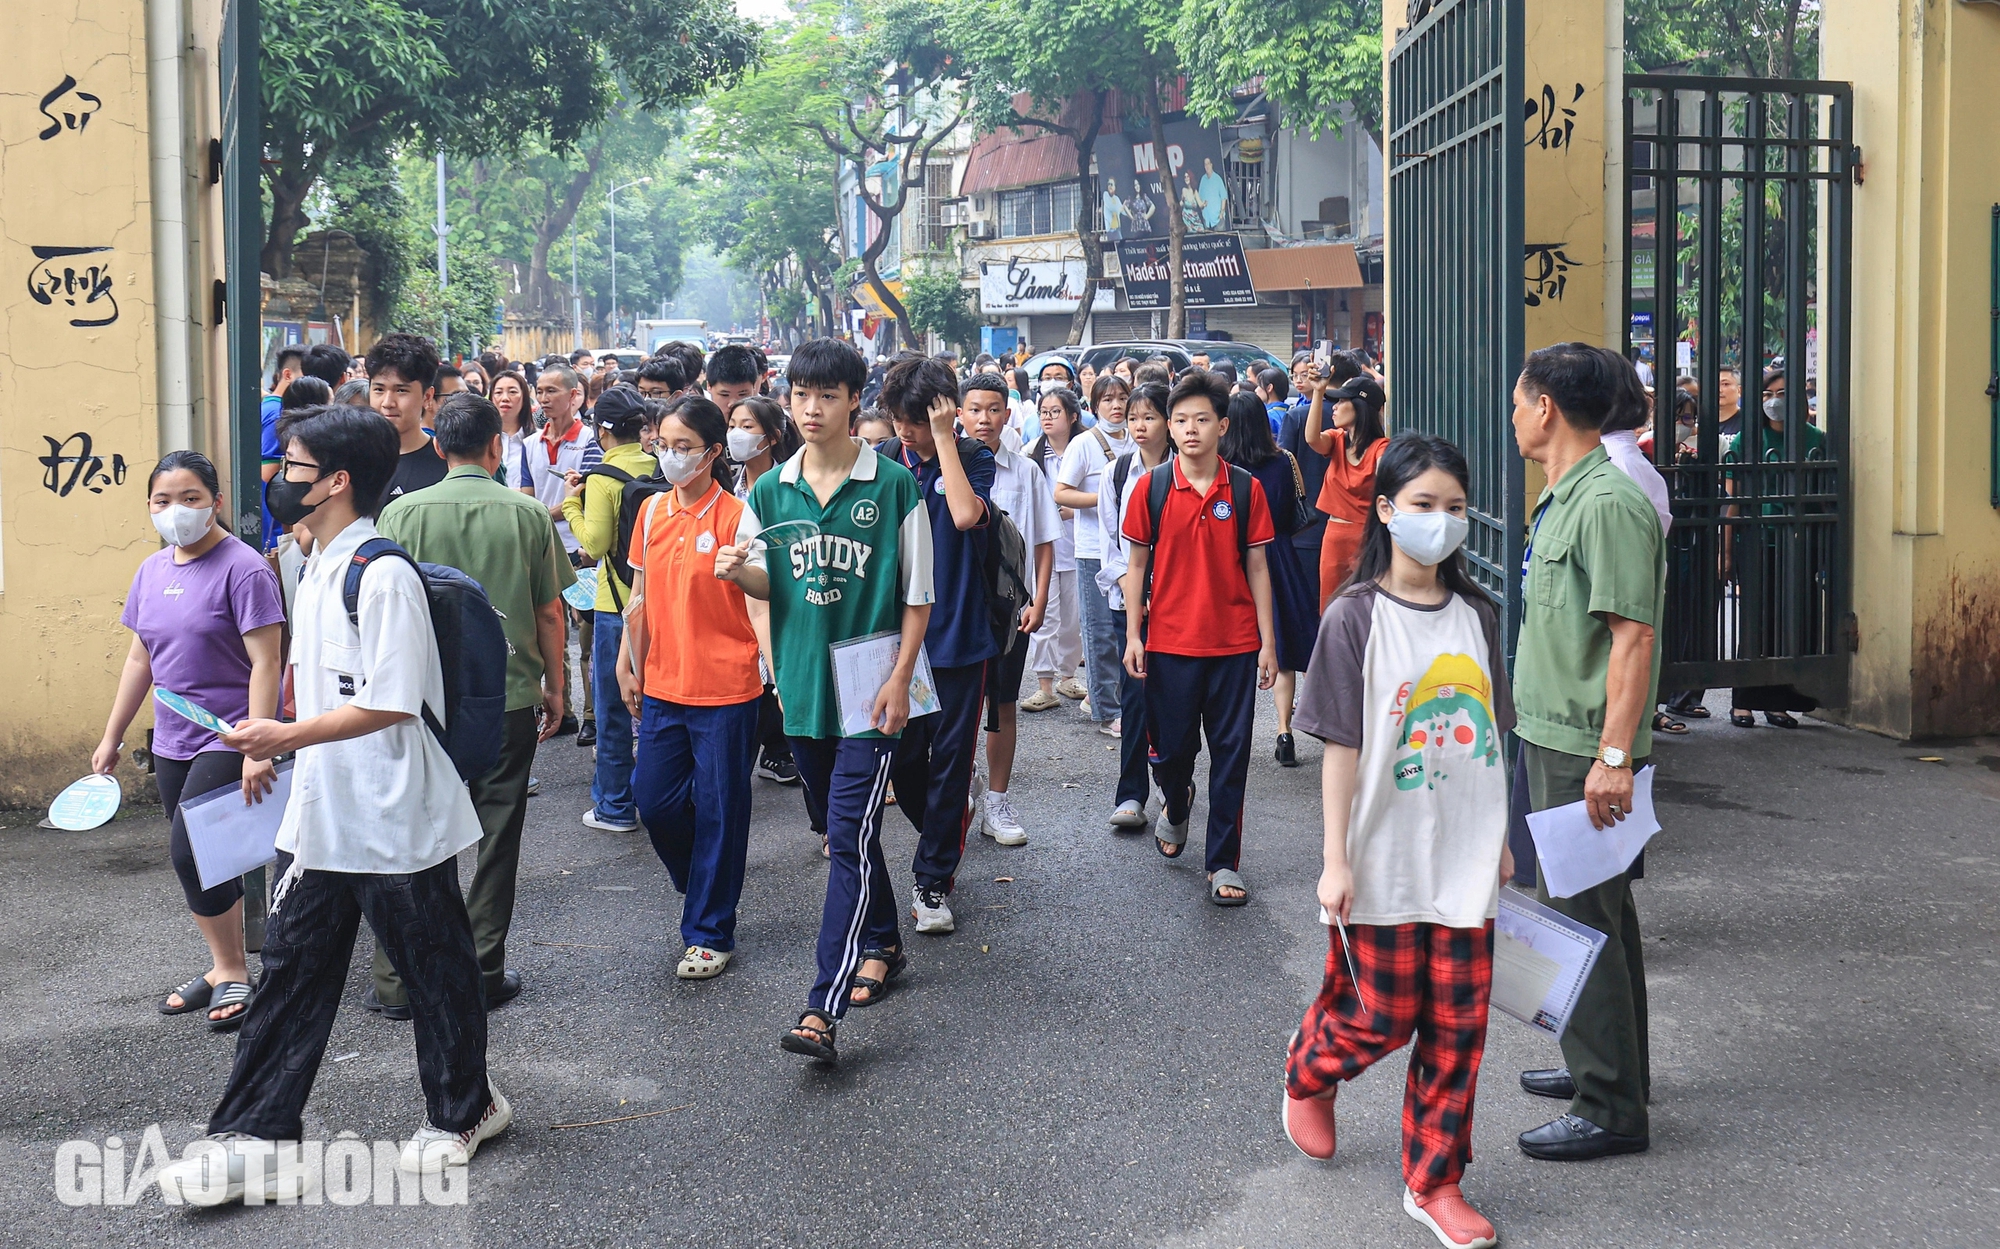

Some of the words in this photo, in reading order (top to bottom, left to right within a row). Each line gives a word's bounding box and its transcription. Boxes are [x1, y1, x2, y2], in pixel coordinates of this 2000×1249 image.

[1133, 142, 1184, 177] Mp
[1126, 262, 1154, 281] Made
[1155, 261, 1167, 280] in
[1167, 254, 1240, 279] etnam1111
[28, 245, 118, 327] Trọng
[1634, 314, 1651, 322] pepsi
[39, 432, 127, 497] Đạo
[855, 507, 874, 521] A2
[790, 534, 872, 579] STUDY
